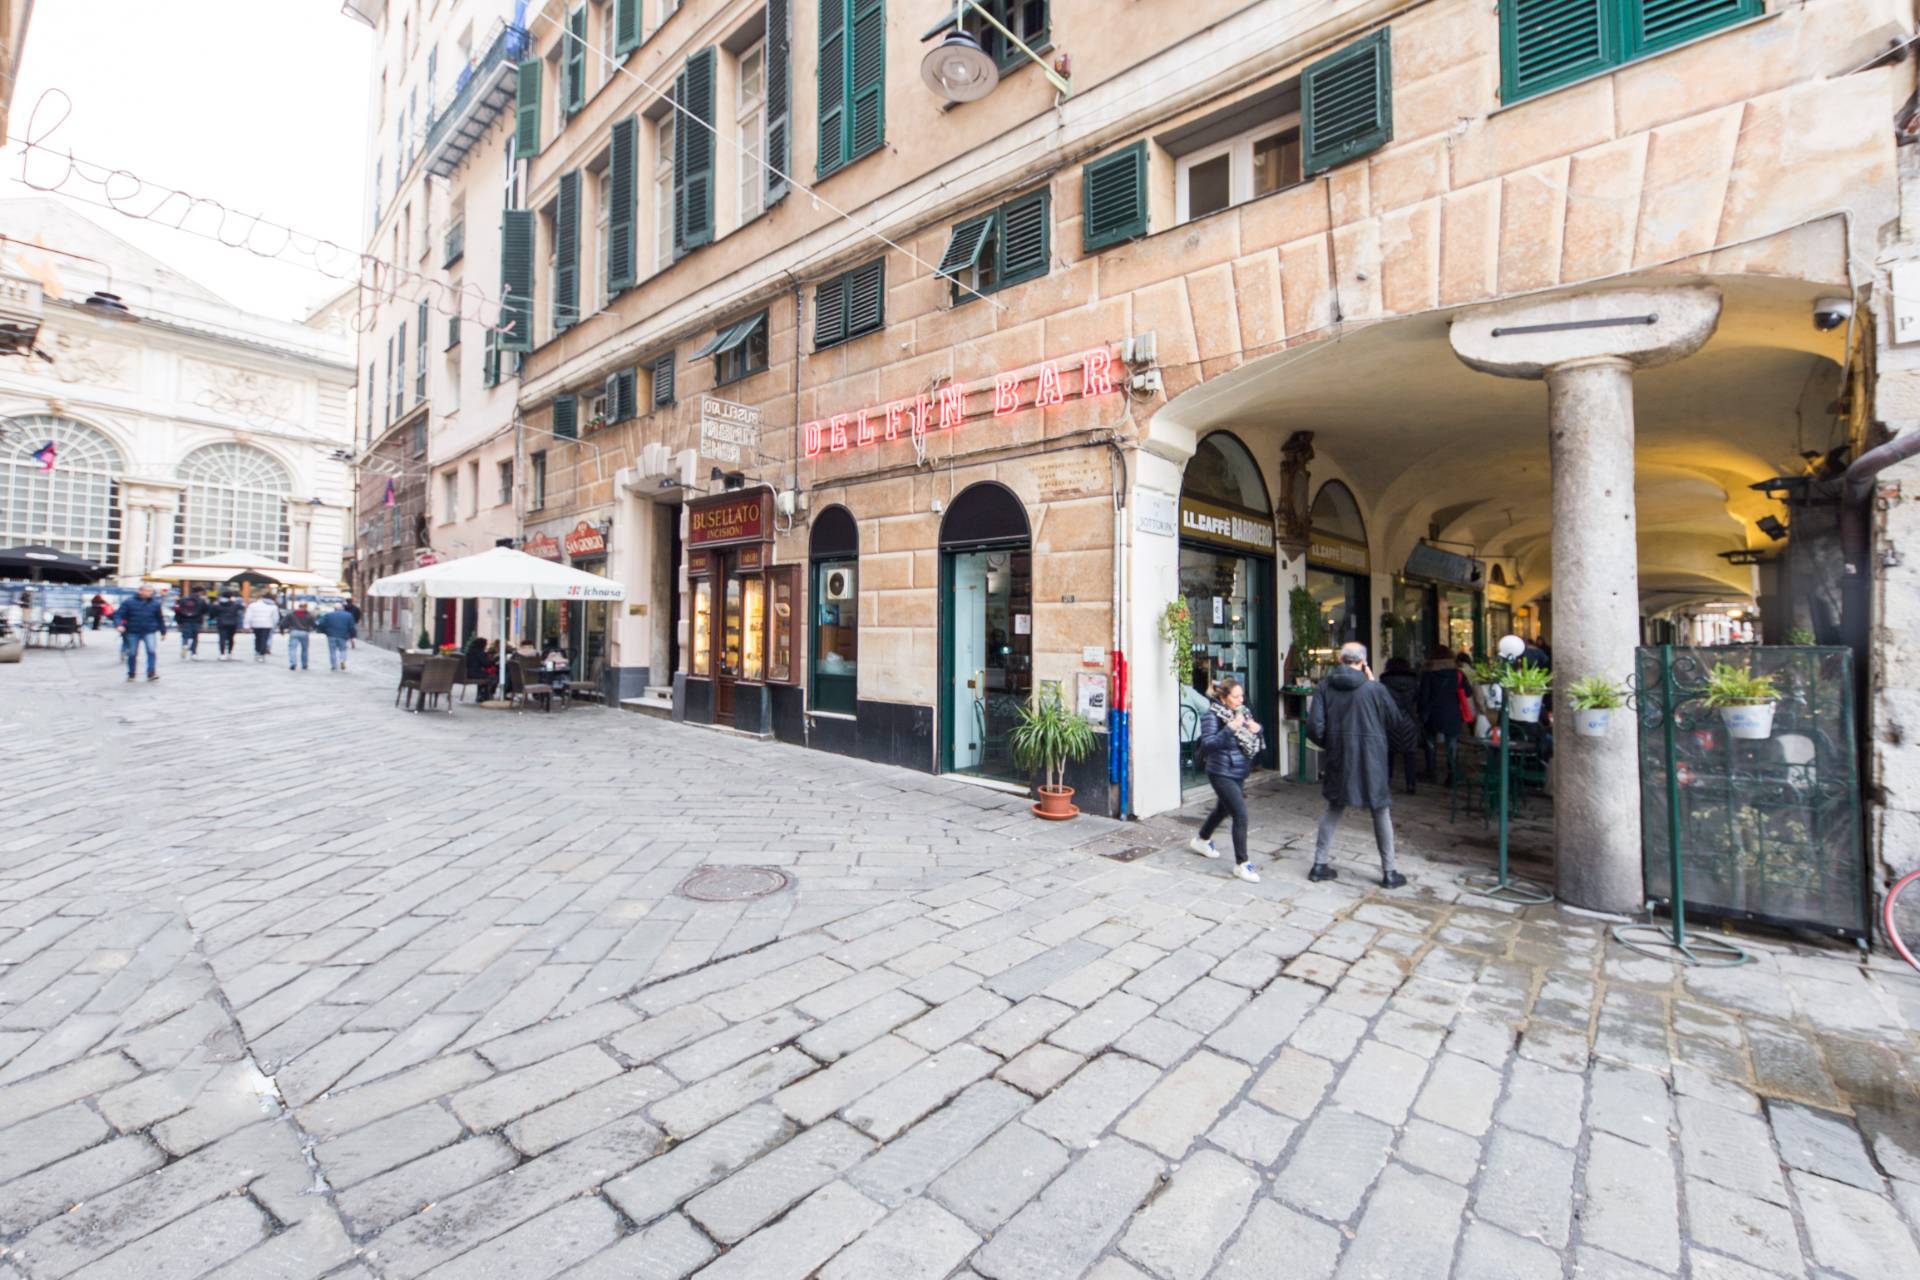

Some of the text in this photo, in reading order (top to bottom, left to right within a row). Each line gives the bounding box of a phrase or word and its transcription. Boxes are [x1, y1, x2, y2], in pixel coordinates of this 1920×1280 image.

[804, 348, 1112, 458] DELFIN BAR
[693, 504, 759, 530] BUSELLATO
[707, 526, 743, 539] INCISIONI
